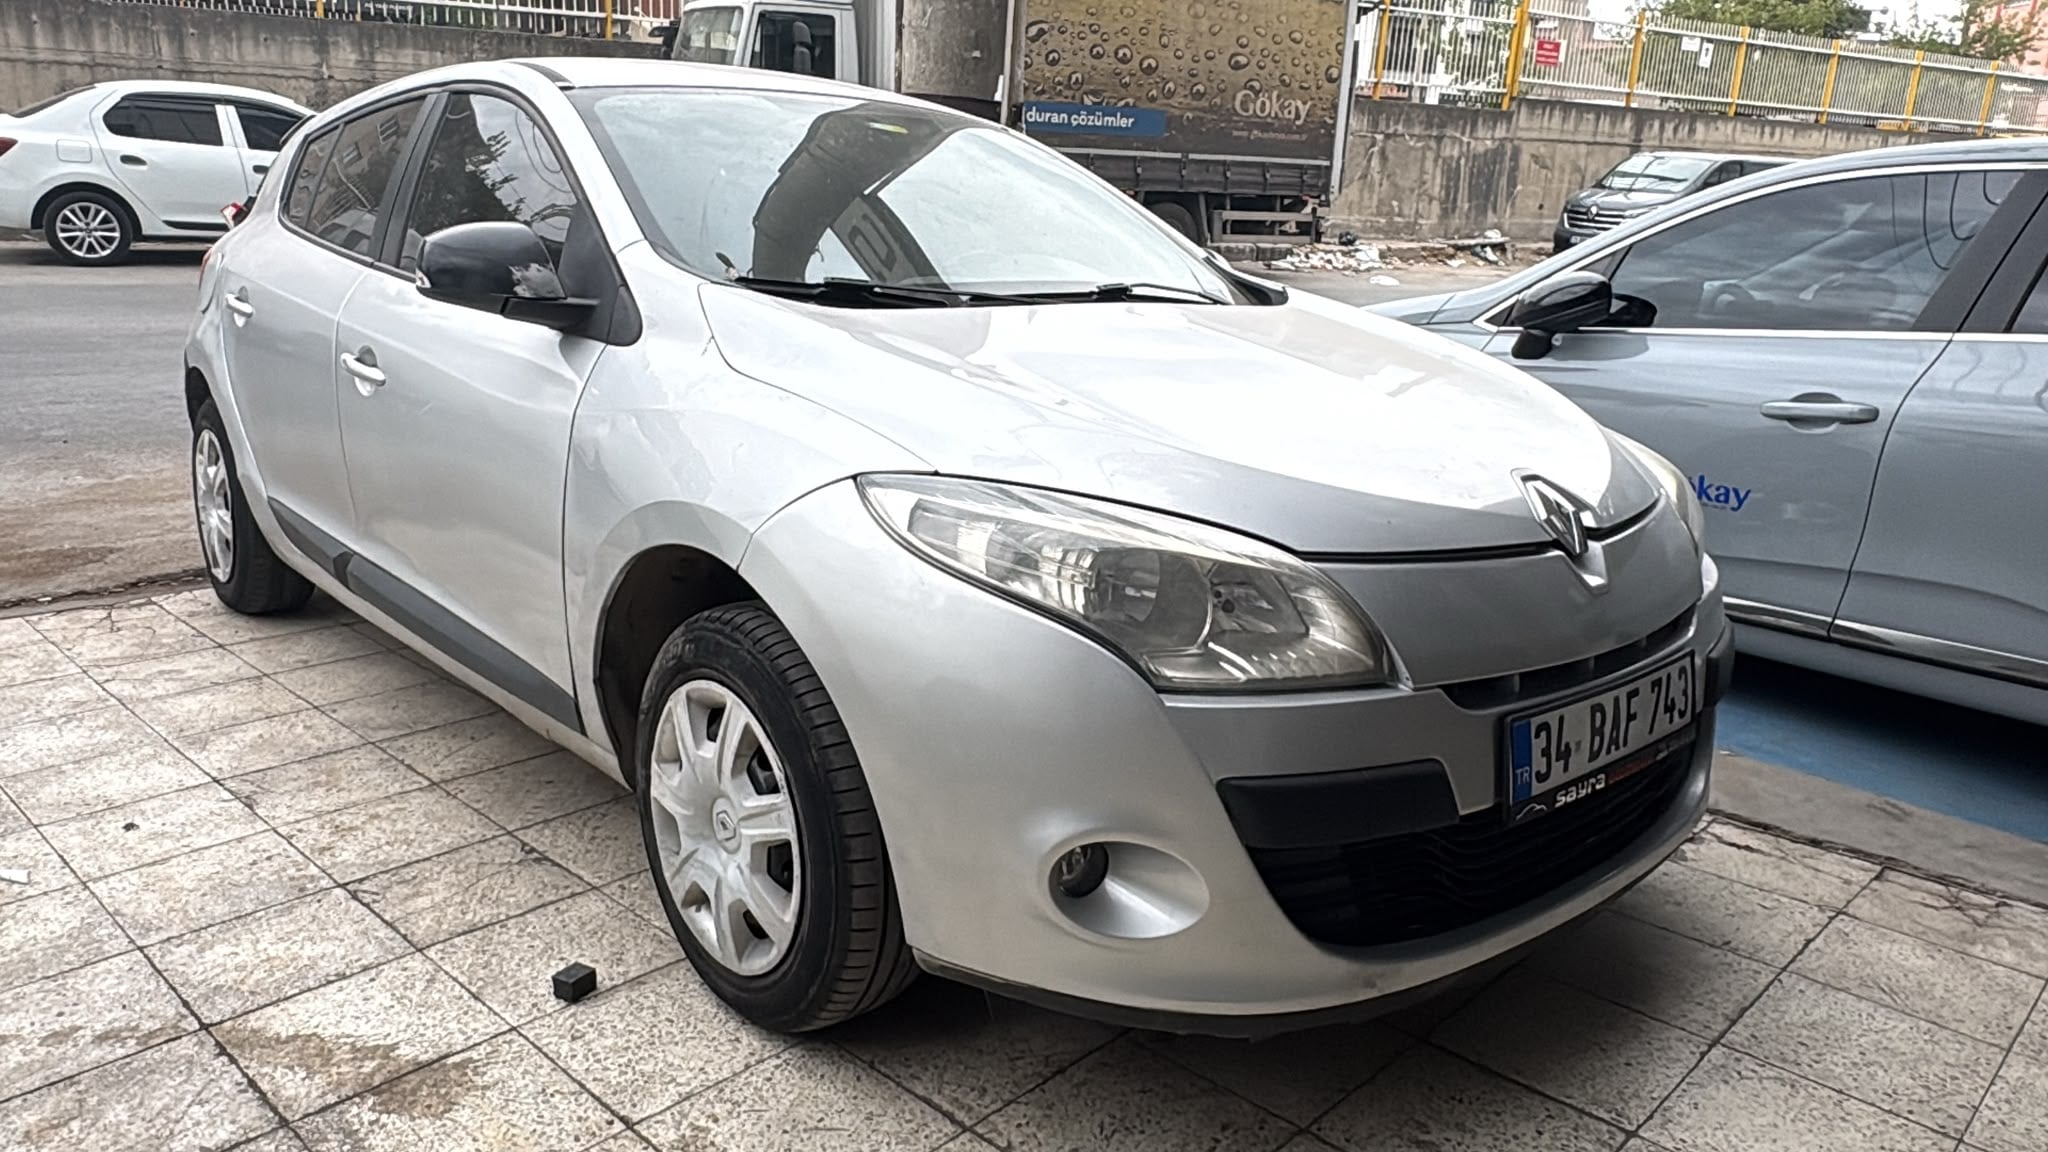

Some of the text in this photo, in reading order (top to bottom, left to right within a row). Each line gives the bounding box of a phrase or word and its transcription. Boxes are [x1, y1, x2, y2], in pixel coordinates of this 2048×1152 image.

[1026, 106, 1135, 128] duran çözümler
[1234, 89, 1311, 125] Gökay
[1689, 475, 1751, 512] kay
[1534, 714, 1572, 784] 34
[1588, 688, 1640, 763] BAF
[1648, 666, 1689, 735] 743
[1515, 766, 1530, 785] TR
[1554, 772, 1606, 808] sayra
